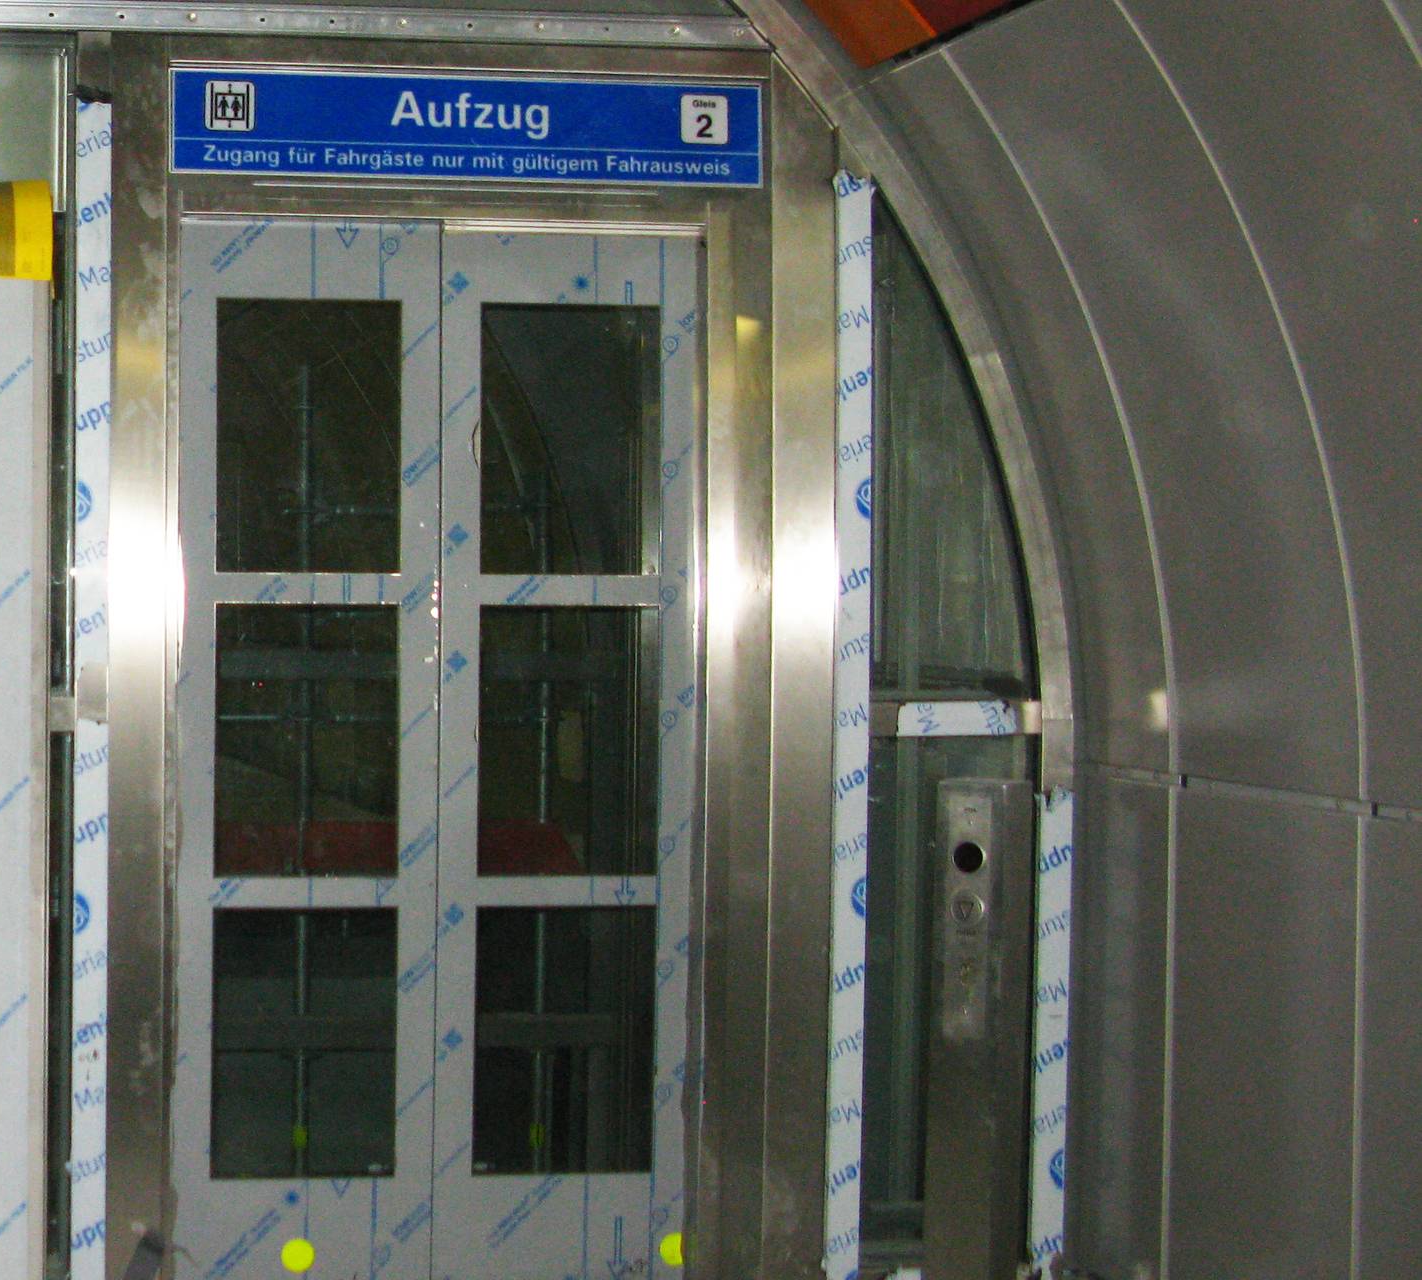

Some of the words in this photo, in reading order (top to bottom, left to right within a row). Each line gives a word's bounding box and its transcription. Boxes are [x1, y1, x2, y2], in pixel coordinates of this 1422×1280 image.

[391, 90, 550, 140] Aufzug
[692, 99, 716, 109] Gleis
[695, 114, 714, 138] 2
[203, 145, 280, 167] Zugang
[289, 149, 316, 165] für
[325, 149, 425, 171] Fahrgäste
[432, 156, 466, 169] nur
[472, 153, 504, 170] mit
[512, 154, 599, 175] gültigem
[605, 155, 731, 176] Fahrausweis
